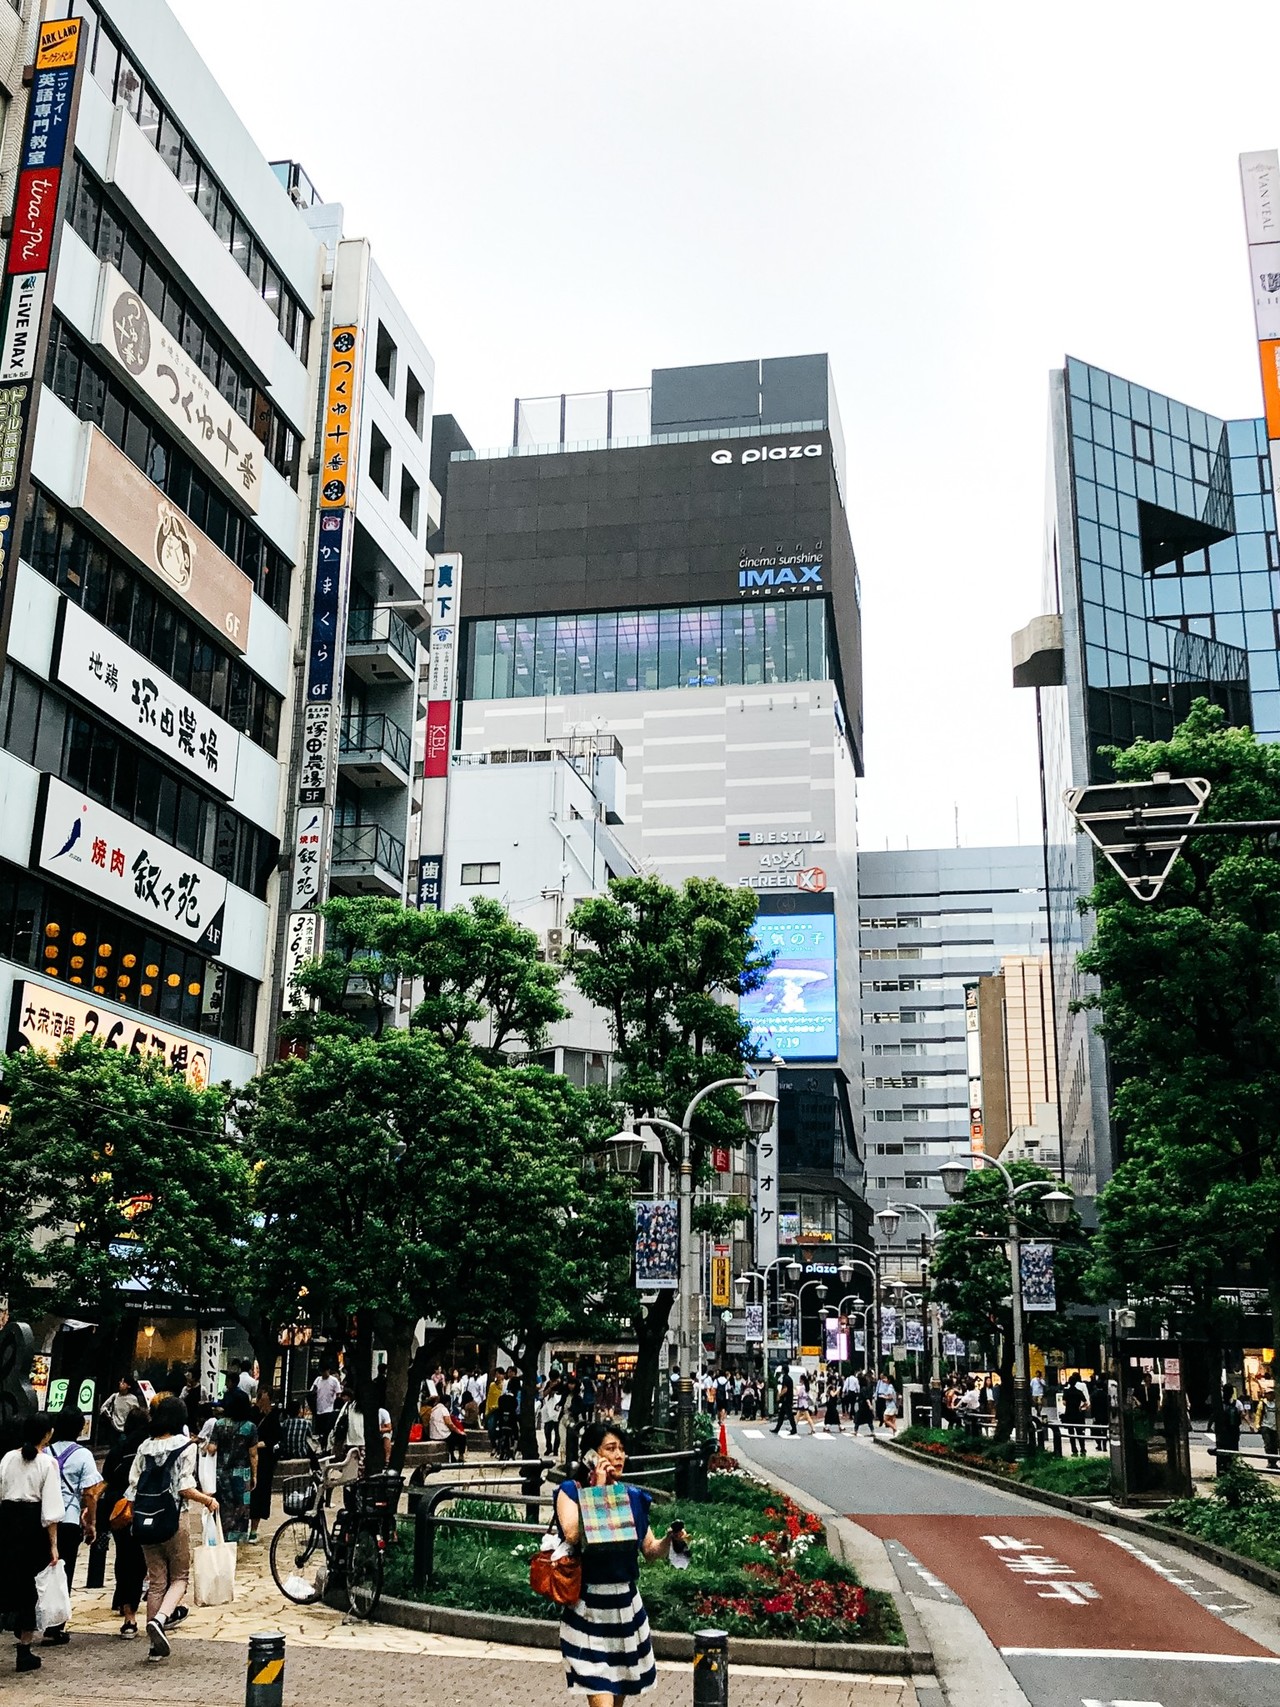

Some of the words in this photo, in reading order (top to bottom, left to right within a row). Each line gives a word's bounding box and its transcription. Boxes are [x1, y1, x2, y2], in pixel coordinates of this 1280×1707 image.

[41, 32, 56, 46] ARK
[58, 25, 78, 41] LAND
[27, 73, 56, 165] 英語専門教室
[10, 332, 27, 369] MAX
[156, 363, 257, 490] つくね十番
[327, 361, 352, 472] つくね十番
[711, 449, 733, 465] Q
[741, 444, 823, 465] plaza
[739, 557, 776, 568] cinema
[778, 552, 823, 565] sunshine
[739, 565, 823, 588] IMAX
[437, 565, 453, 618] 真下
[739, 584, 824, 596] THEATRE
[317, 545, 340, 662] かまくら
[225, 613, 241, 639] 6F
[312, 683, 329, 696] 6F
[303, 721, 328, 787] 塚田農場
[432, 725, 446, 758] KBL
[305, 790, 319, 801] 5F
[299, 834, 319, 844] 焼肉
[755, 831, 825, 844] BESTIA
[91, 836, 126, 878] 焼肉
[131, 848, 201, 929] 叙々苑
[296, 848, 318, 895] 叙々苑
[206, 924, 221, 945] 4F
[23, 1002, 76, 1040] 大衆酒場
[775, 1037, 800, 1048] 7.19
[760, 1143, 775, 1224] ラオケ
[806, 1264, 837, 1274] plaza
